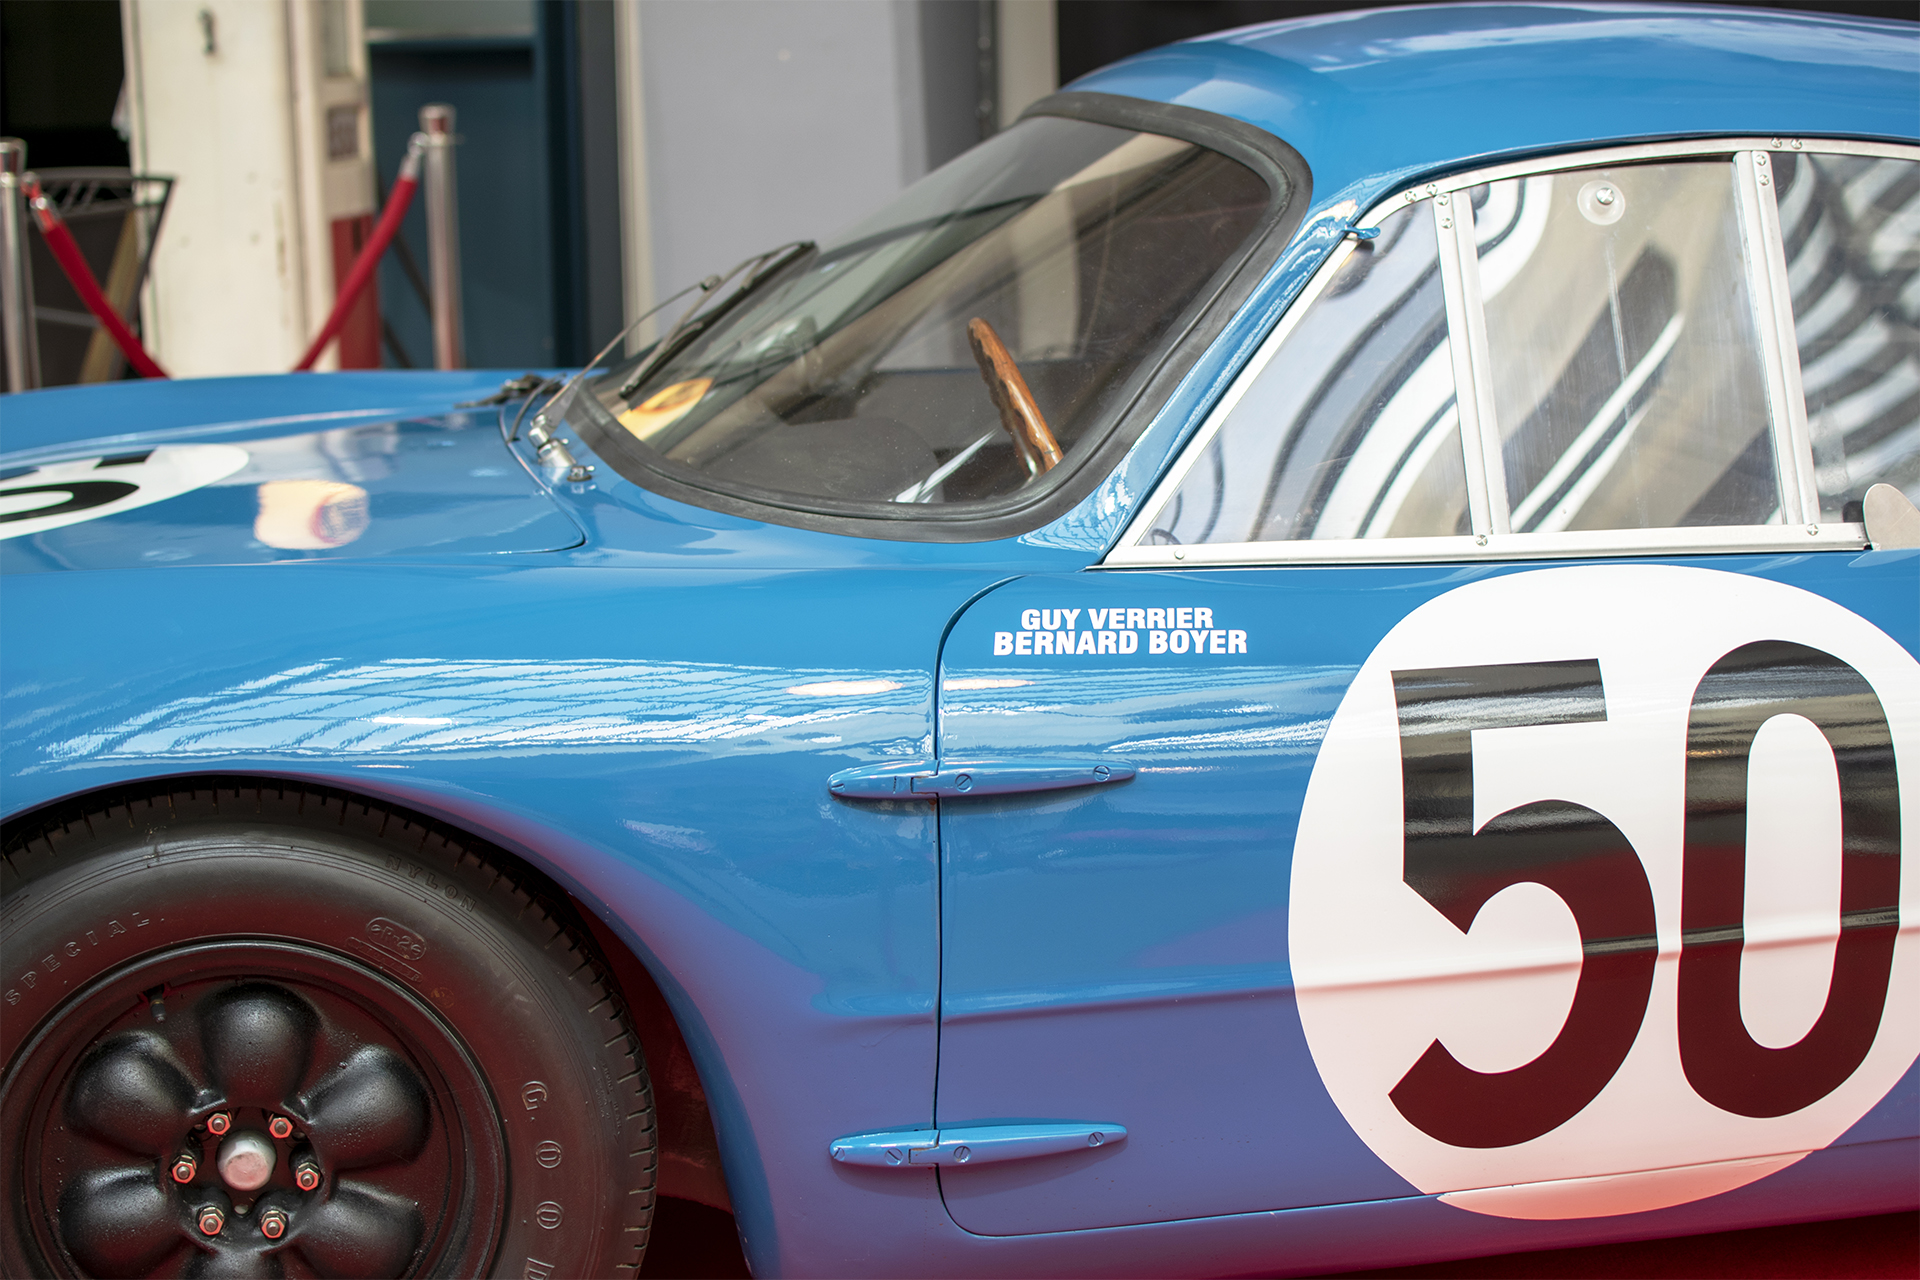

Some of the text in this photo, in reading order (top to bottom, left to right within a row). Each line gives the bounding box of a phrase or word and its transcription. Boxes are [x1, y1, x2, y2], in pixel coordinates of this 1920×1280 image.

[993, 629, 1248, 656] BERNARD BOYER
[1021, 607, 1214, 631] GUY VERRIER
[385, 854, 477, 912] NYLON
[1387, 639, 1902, 1149] 50
[5, 911, 150, 1006] SPECIAL
